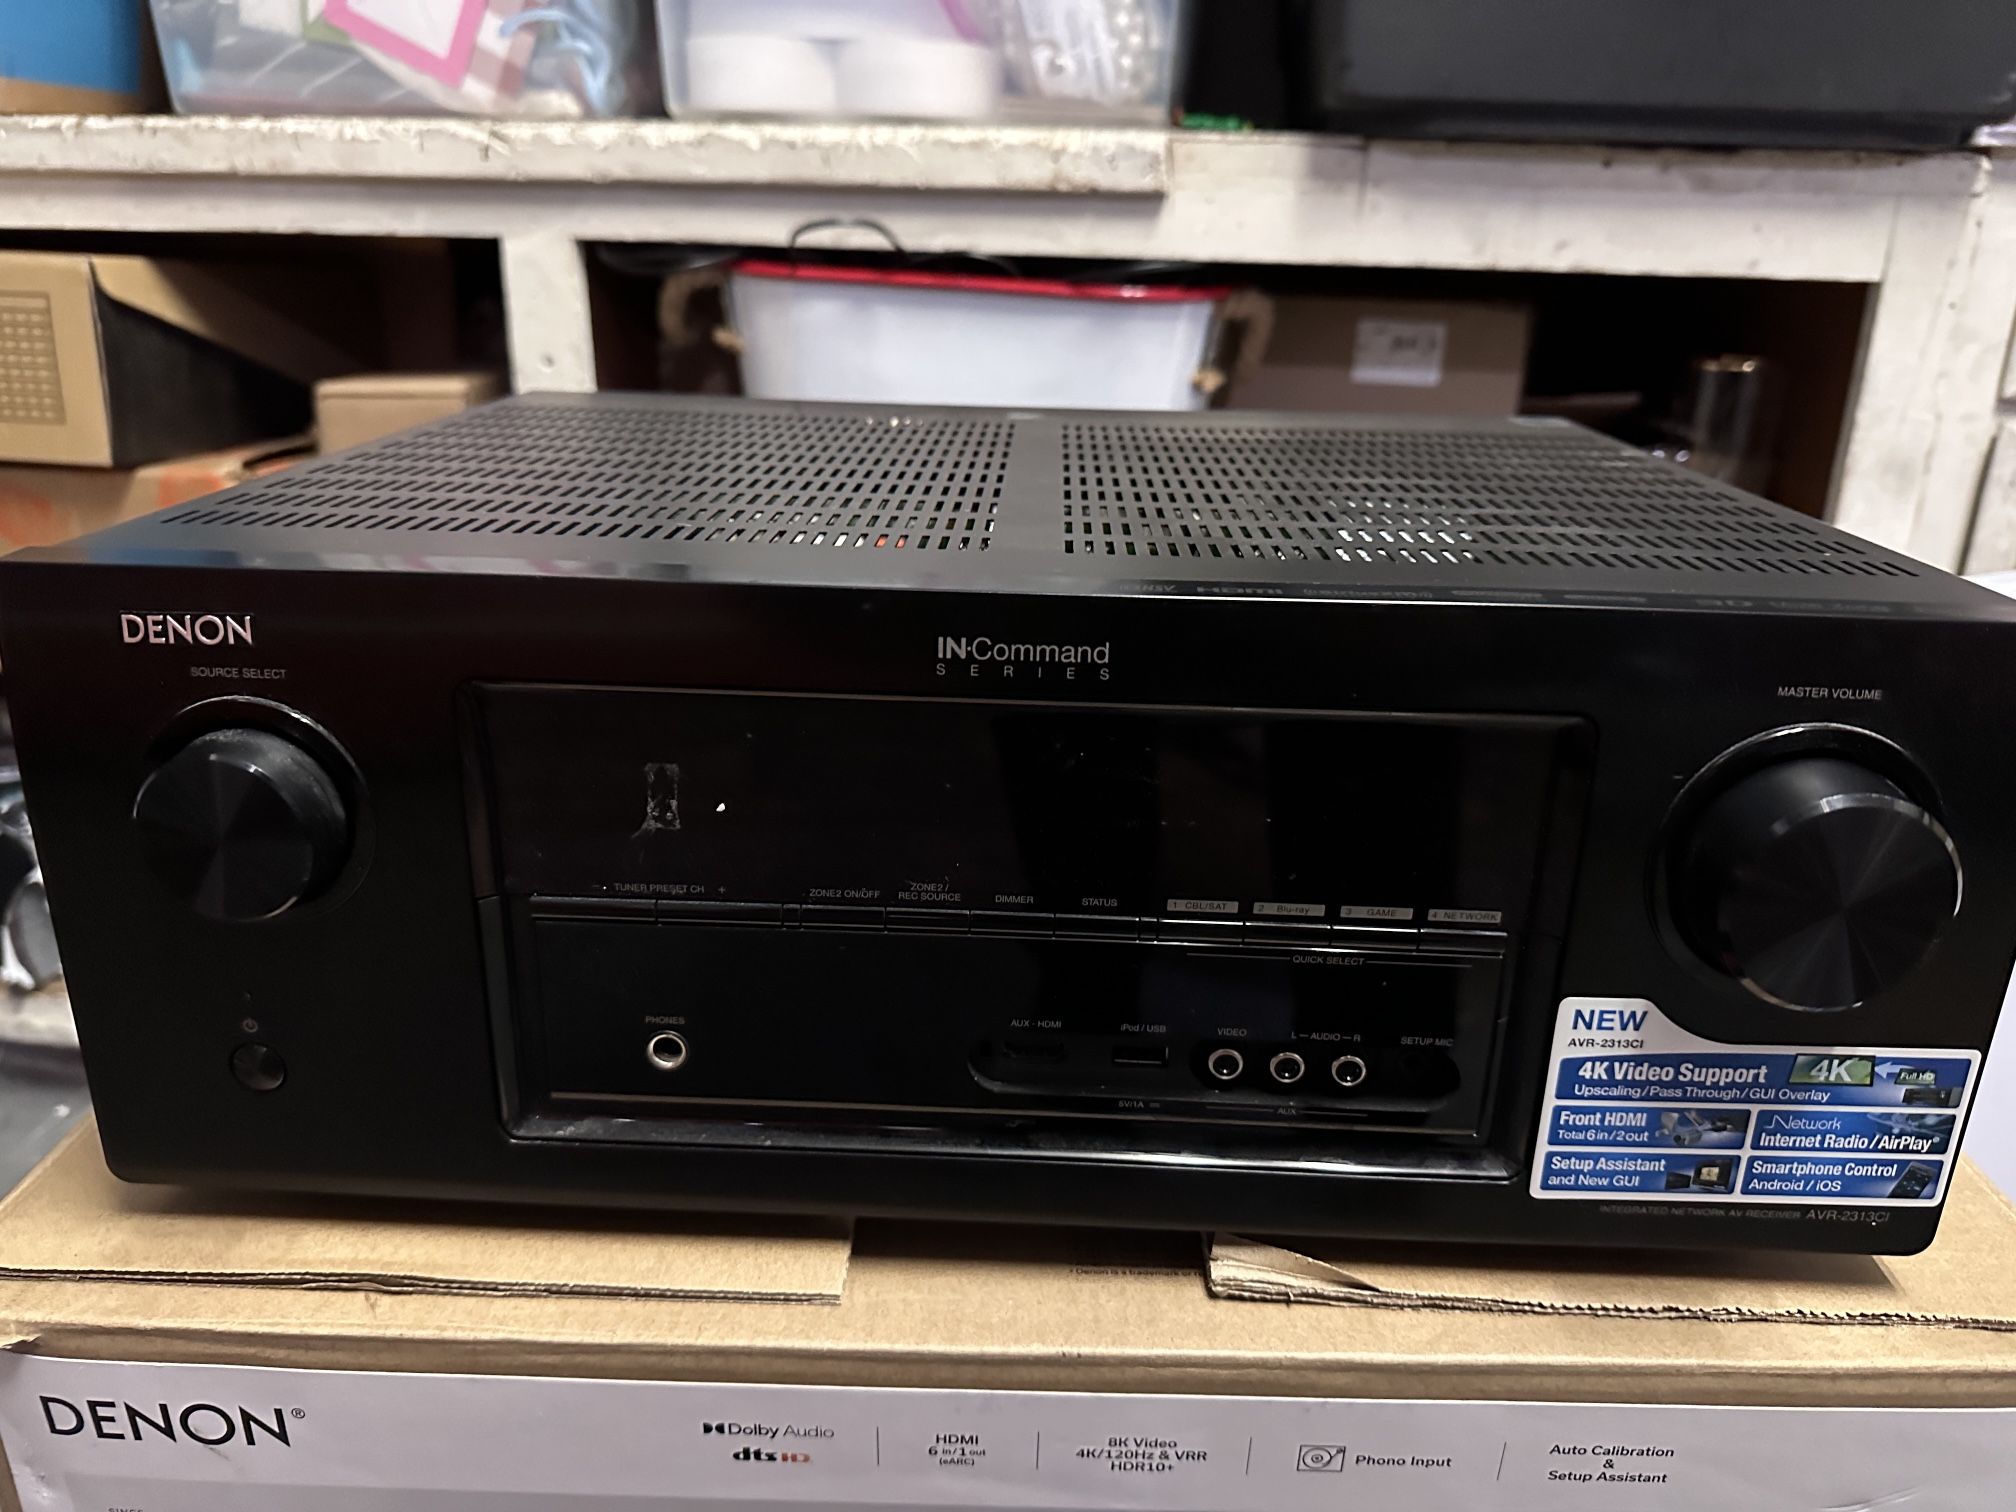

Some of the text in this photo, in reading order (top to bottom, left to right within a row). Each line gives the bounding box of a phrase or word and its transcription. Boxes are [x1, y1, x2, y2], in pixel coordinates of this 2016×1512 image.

[120, 613, 254, 646] DENON
[190, 666, 287, 680] SOURCE SELECT
[1777, 686, 1883, 700] MASTER VOLUME
[614, 882, 647, 893] TUNER
[649, 883, 687, 894] PRESET
[690, 884, 705, 894] CH
[809, 887, 881, 900] ZONE2 ON/OFF
[898, 891, 961, 903] REC SOURCE
[995, 894, 1034, 905] DIMMER
[1081, 897, 1118, 908] STATUS
[1185, 901, 1228, 912] CBL/SAT
[1276, 905, 1310, 916] Blu-ray
[1366, 909, 1397, 918] GAME
[1431, 911, 1499, 922] 4 NETWORK
[1292, 955, 1365, 967] QUICK SELECT
[645, 1015, 686, 1025] PHONES
[1010, 1018, 1030, 1029] AUX
[1037, 1020, 1062, 1030] HDMI
[1572, 1009, 1649, 1032] NEW
[1120, 1023, 1139, 1033] iPod
[1146, 1024, 1167, 1034] USB
[1217, 1027, 1247, 1038] VIDEO
[1291, 1032, 1361, 1043] L AUDIO R
[1400, 1036, 1454, 1047] SETUP MIC
[1568, 1038, 1645, 1050] AVR-2313CI
[1578, 1061, 1769, 1087] 4K Video Support
[1810, 1059, 1853, 1083] 4K
[1900, 1071, 1918, 1082] Full
[1778, 1090, 1831, 1102] Overlay
[1277, 1106, 1297, 1116] AUX
[1559, 1111, 1647, 1128] Front HDMI
[1763, 1114, 1842, 1131] Network
[1557, 1130, 1586, 1141] Total
[1759, 1132, 1821, 1150] Internet
[1550, 1156, 1666, 1173] Setup Assistant
[1752, 1160, 1898, 1178] Smartphone Control
[1547, 1176, 1640, 1188] and New GUI
[1748, 1179, 1805, 1190] Android
[1816, 1181, 1842, 1192] iOS
[1599, 1204, 1891, 1223] INTEGRATED NETWORK AV RECEIVER AVR-2313CI
[728, 1423, 834, 1439] Dolby Audio
[936, 1434, 979, 1446] HDMI
[1109, 1437, 1177, 1448] 8K Video
[732, 1447, 777, 1461] dts
[928, 1446, 938, 1456] 6
[1076, 1448, 1207, 1461] 4K/120Hz & VRR
[1549, 1444, 1674, 1458] Auto Calibration
[939, 1457, 975, 1466] (eARC)
[1111, 1461, 1174, 1472] HDR10+
[1355, 1454, 1452, 1468] Phono Input
[1602, 1459, 1615, 1470] &
[1548, 1470, 1668, 1484] Setup Assistant
